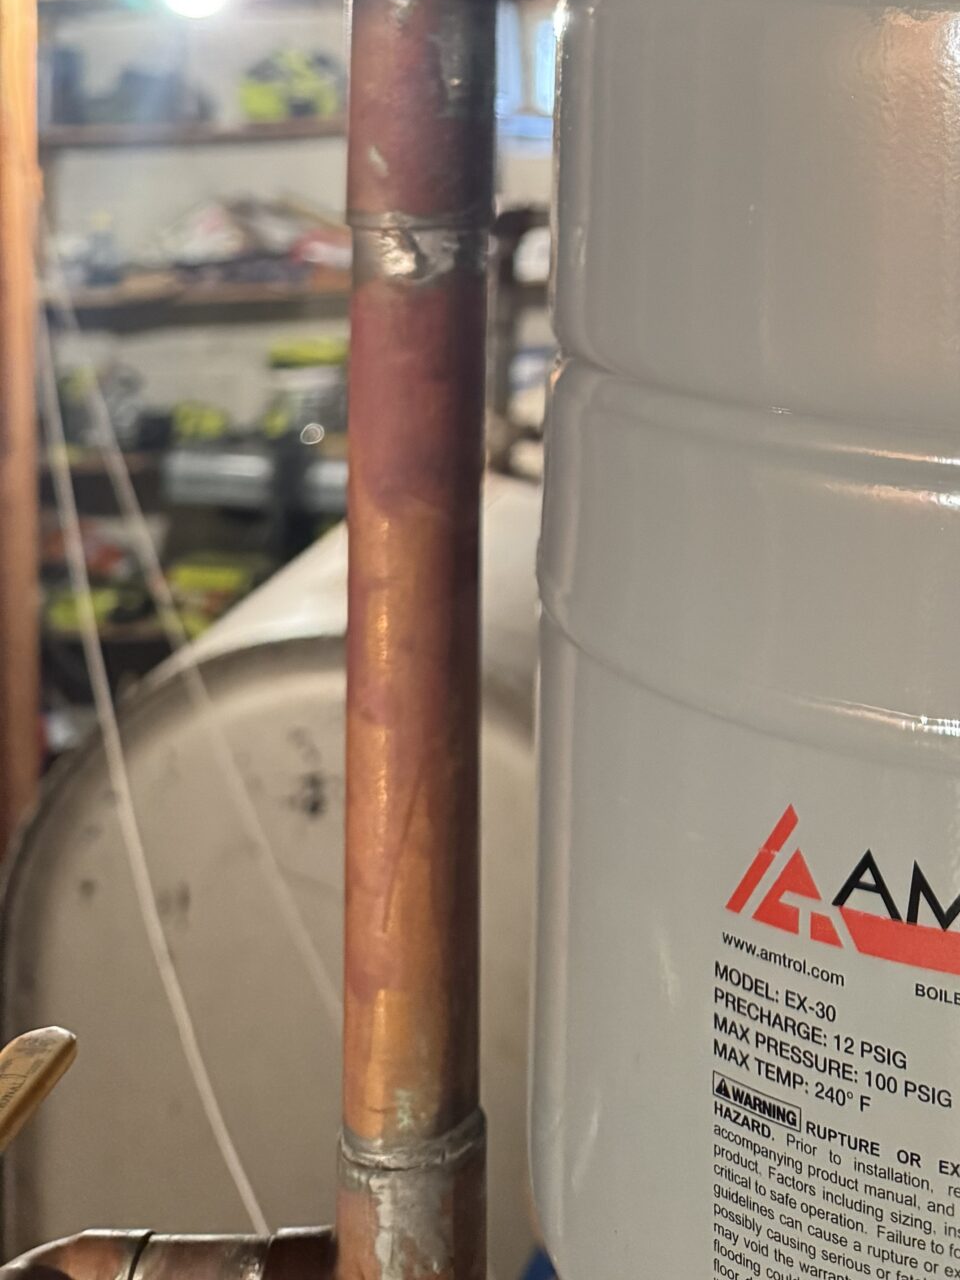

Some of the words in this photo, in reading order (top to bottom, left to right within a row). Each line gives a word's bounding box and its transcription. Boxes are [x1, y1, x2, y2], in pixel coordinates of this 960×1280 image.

[714, 960, 779, 1003] MODEL:
[785, 989, 837, 1023] EX-30
[722, 931, 845, 987] www.amtrol.com
[713, 1012, 750, 1045] MAX
[755, 1033, 858, 1084] PRESSURE:
[865, 1070, 898, 1094] 100
[904, 1080, 953, 1109] PSIG
[714, 987, 828, 1047] PRECHARGE:
[834, 1033, 855, 1055] 12
[860, 1040, 908, 1070] PSIG
[713, 1038, 750, 1071] MAX
[754, 1057, 809, 1094] TEMP:
[815, 1082, 853, 1107] 240°
[860, 1095, 872, 1112] F
[714, 1100, 775, 1141] HAZARD.
[786, 1133, 818, 1157] Prior
[829, 1149, 842, 1166] to
[854, 1157, 934, 1194] installation,
[731, 1085, 798, 1127] WARNING
[806, 1120, 880, 1157] RUPTURE
[897, 1149, 922, 1168] OR
[713, 1144, 762, 1176] product.
[768, 1165, 816, 1197] Factors
[822, 1186, 884, 1223] including
[890, 1210, 937, 1236] sizing,
[713, 1163, 751, 1190] critical
[755, 1180, 767, 1196] to
[770, 1189, 797, 1210] safe
[801, 1201, 868, 1235] operation.
[877, 1224, 926, 1251] Failure
[930, 1239, 945, 1255] to
[714, 1123, 803, 1174] accompanying
[808, 1164, 859, 1192] product
[864, 1183, 921, 1210] manual,
[927, 1200, 955, 1217] and
[713, 1183, 775, 1220] guidelines
[779, 1213, 803, 1233] can
[807, 1224, 848, 1248] cause
[853, 1240, 862, 1252] a
[867, 1244, 918, 1269] rupture
[923, 1260, 939, 1274] or
[713, 1203, 763, 1237] possibly
[766, 1227, 817, 1260] causing
[821, 1248, 872, 1275] serious
[876, 1267, 892, 1280] or
[713, 1222, 739, 1246] may
[743, 1237, 769, 1257] void
[774, 1248, 794, 1268] the
[713, 1238, 761, 1277] flooding
[713, 1258, 739, 1280] floor
